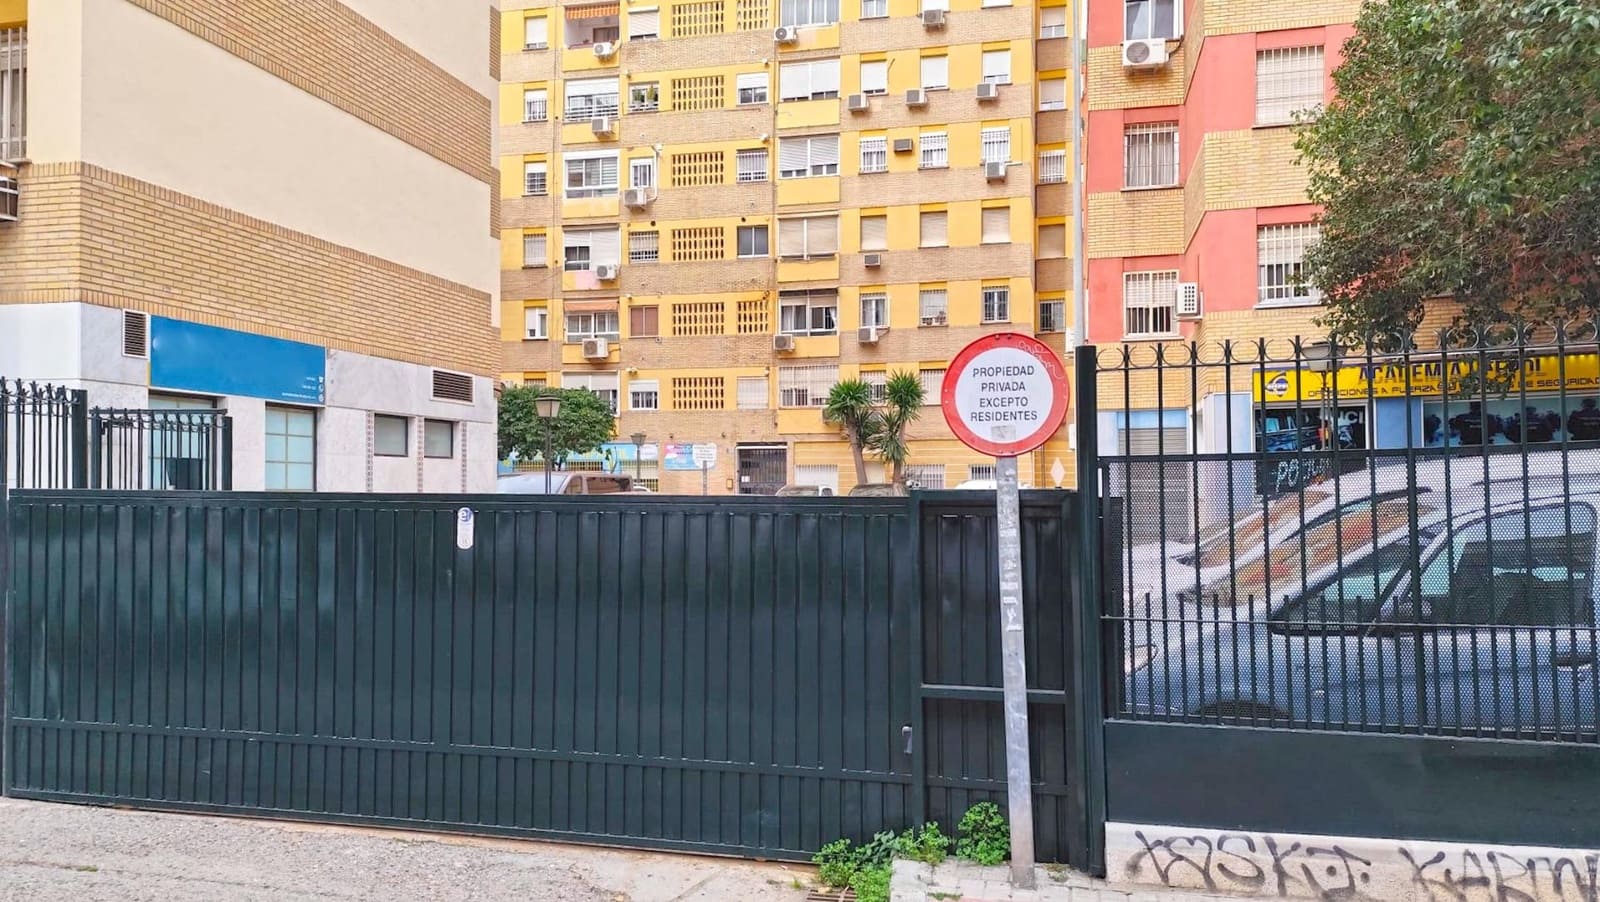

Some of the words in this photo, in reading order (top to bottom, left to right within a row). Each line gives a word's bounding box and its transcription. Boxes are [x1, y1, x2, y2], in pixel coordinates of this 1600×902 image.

[972, 365, 1035, 378] PROPIEDAD
[981, 381, 1026, 392] PRIVADA
[979, 396, 1029, 408] EXCEPTO
[970, 410, 1038, 422] RESIDENTES
